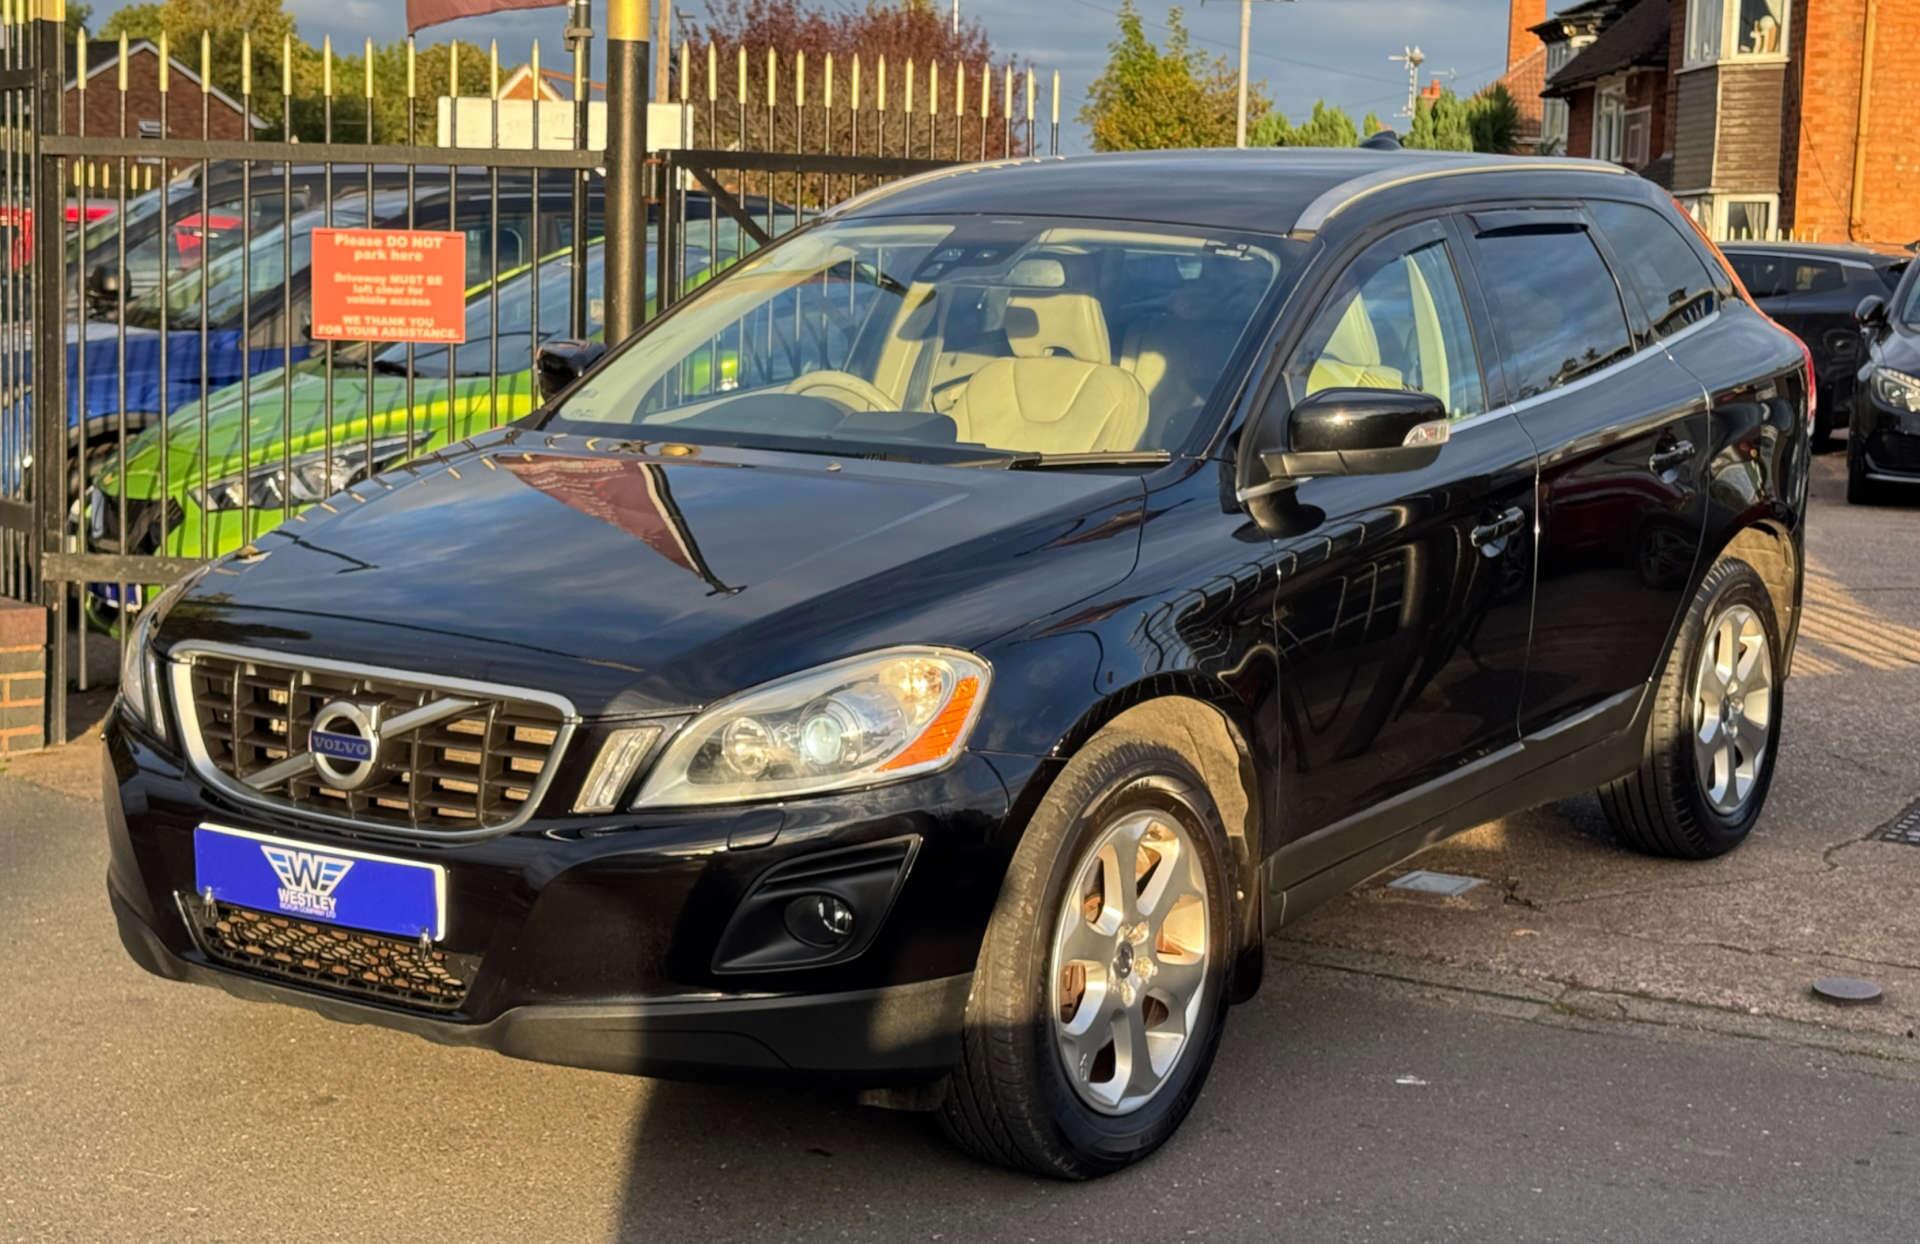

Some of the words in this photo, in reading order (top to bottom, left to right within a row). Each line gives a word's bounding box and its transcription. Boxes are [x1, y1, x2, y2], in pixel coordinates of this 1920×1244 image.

[334, 233, 383, 247] Please
[386, 235, 408, 248] DO
[412, 236, 443, 249] NOT
[353, 249, 387, 262] park
[390, 249, 423, 262] here
[334, 271, 386, 285] Driveway
[389, 273, 423, 285] MUST
[353, 284, 373, 294] left
[375, 285, 405, 295] clear
[407, 286, 424, 295] for
[346, 295, 387, 305] vehicle
[342, 315, 361, 325] WE
[364, 315, 405, 326] THANK
[409, 317, 434, 327] YOU
[318, 325, 342, 335] FOR
[345, 326, 378, 336] YOUR
[381, 327, 459, 339] ASSISTANCE.
[312, 735, 369, 755] VOLVO
[277, 887, 338, 912] WESTLEY
